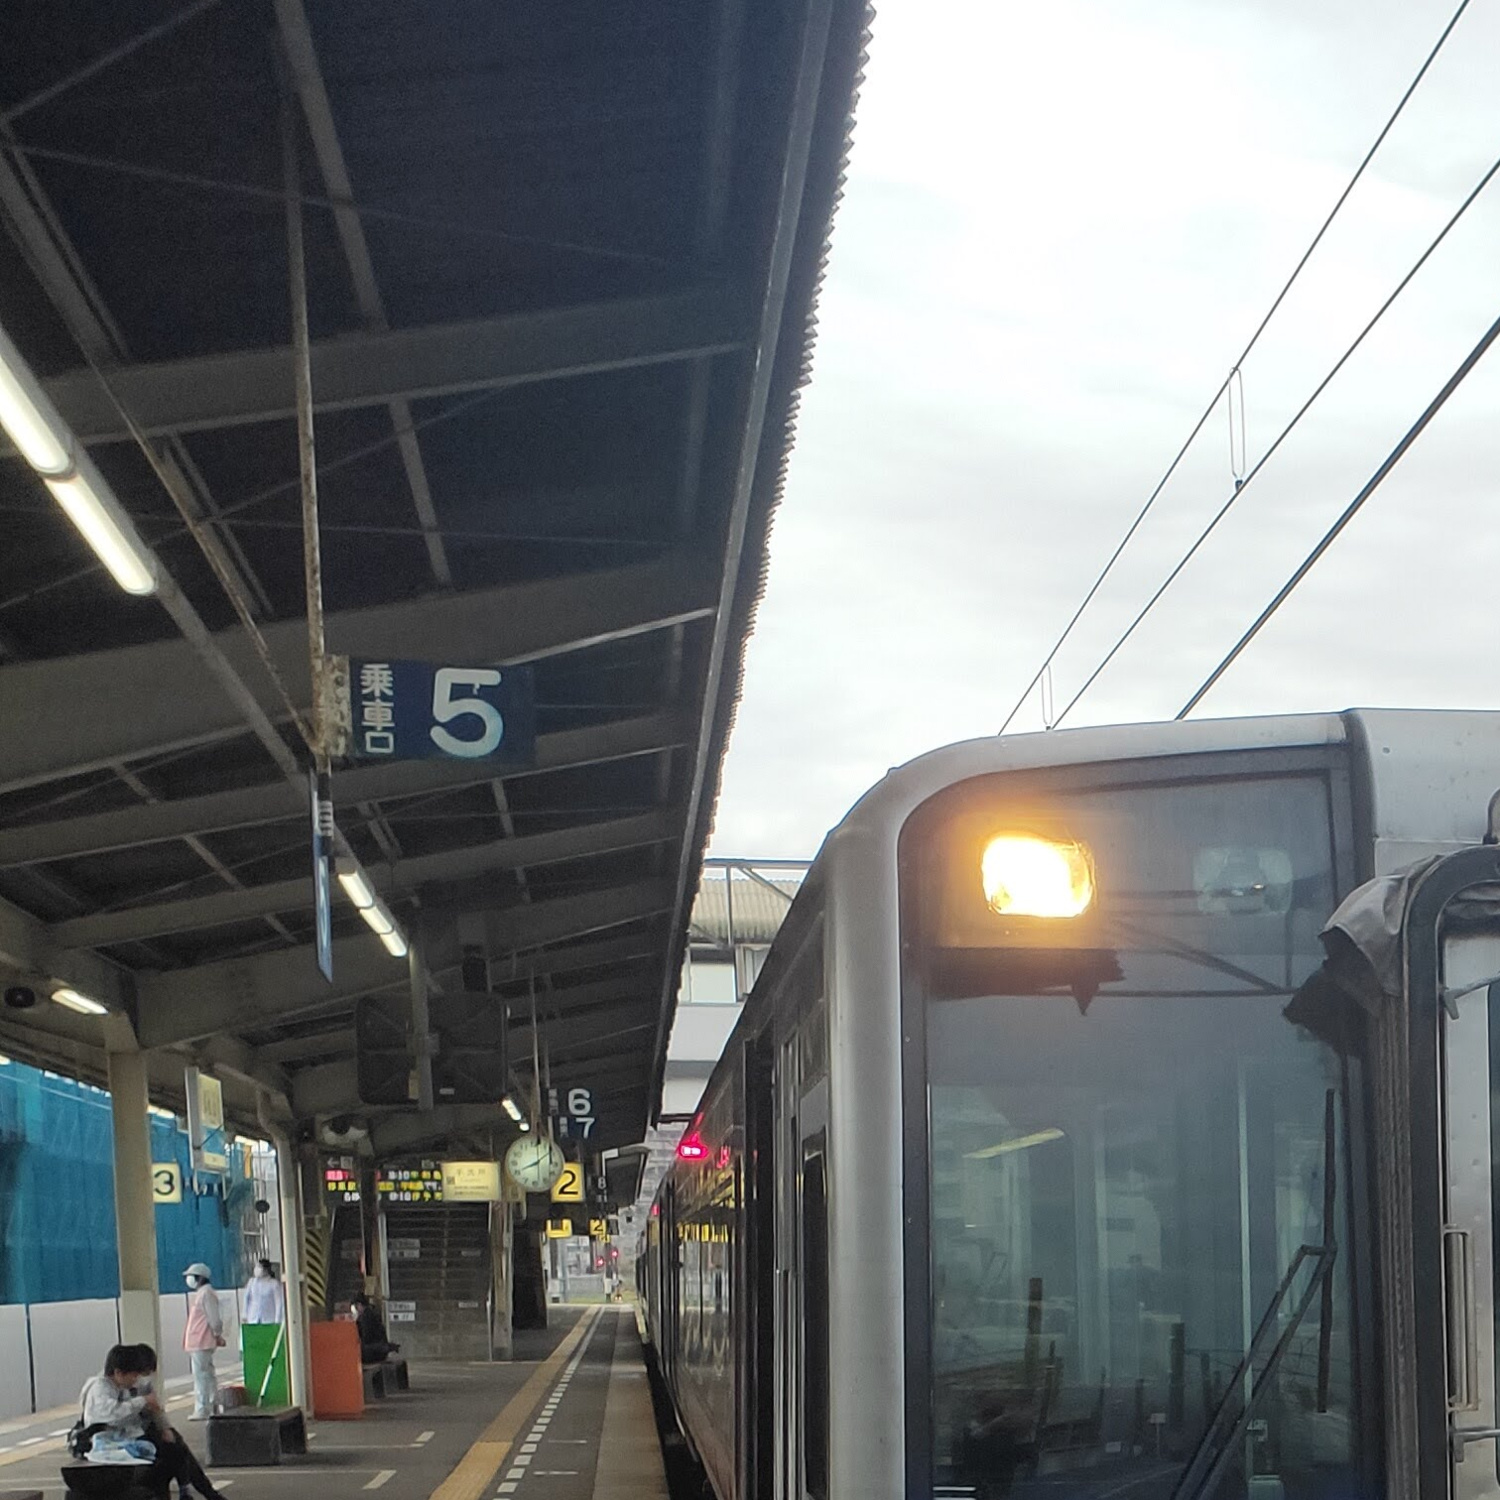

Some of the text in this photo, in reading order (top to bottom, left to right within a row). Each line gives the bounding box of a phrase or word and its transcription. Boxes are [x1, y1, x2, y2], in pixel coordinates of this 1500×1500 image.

[360, 663, 396, 754] 乗車口
[430, 667, 503, 758] 5
[568, 1088, 591, 1116] 6
[575, 1117, 595, 1139] 7
[154, 1170, 175, 1196] 3
[558, 1170, 579, 1195] 2
